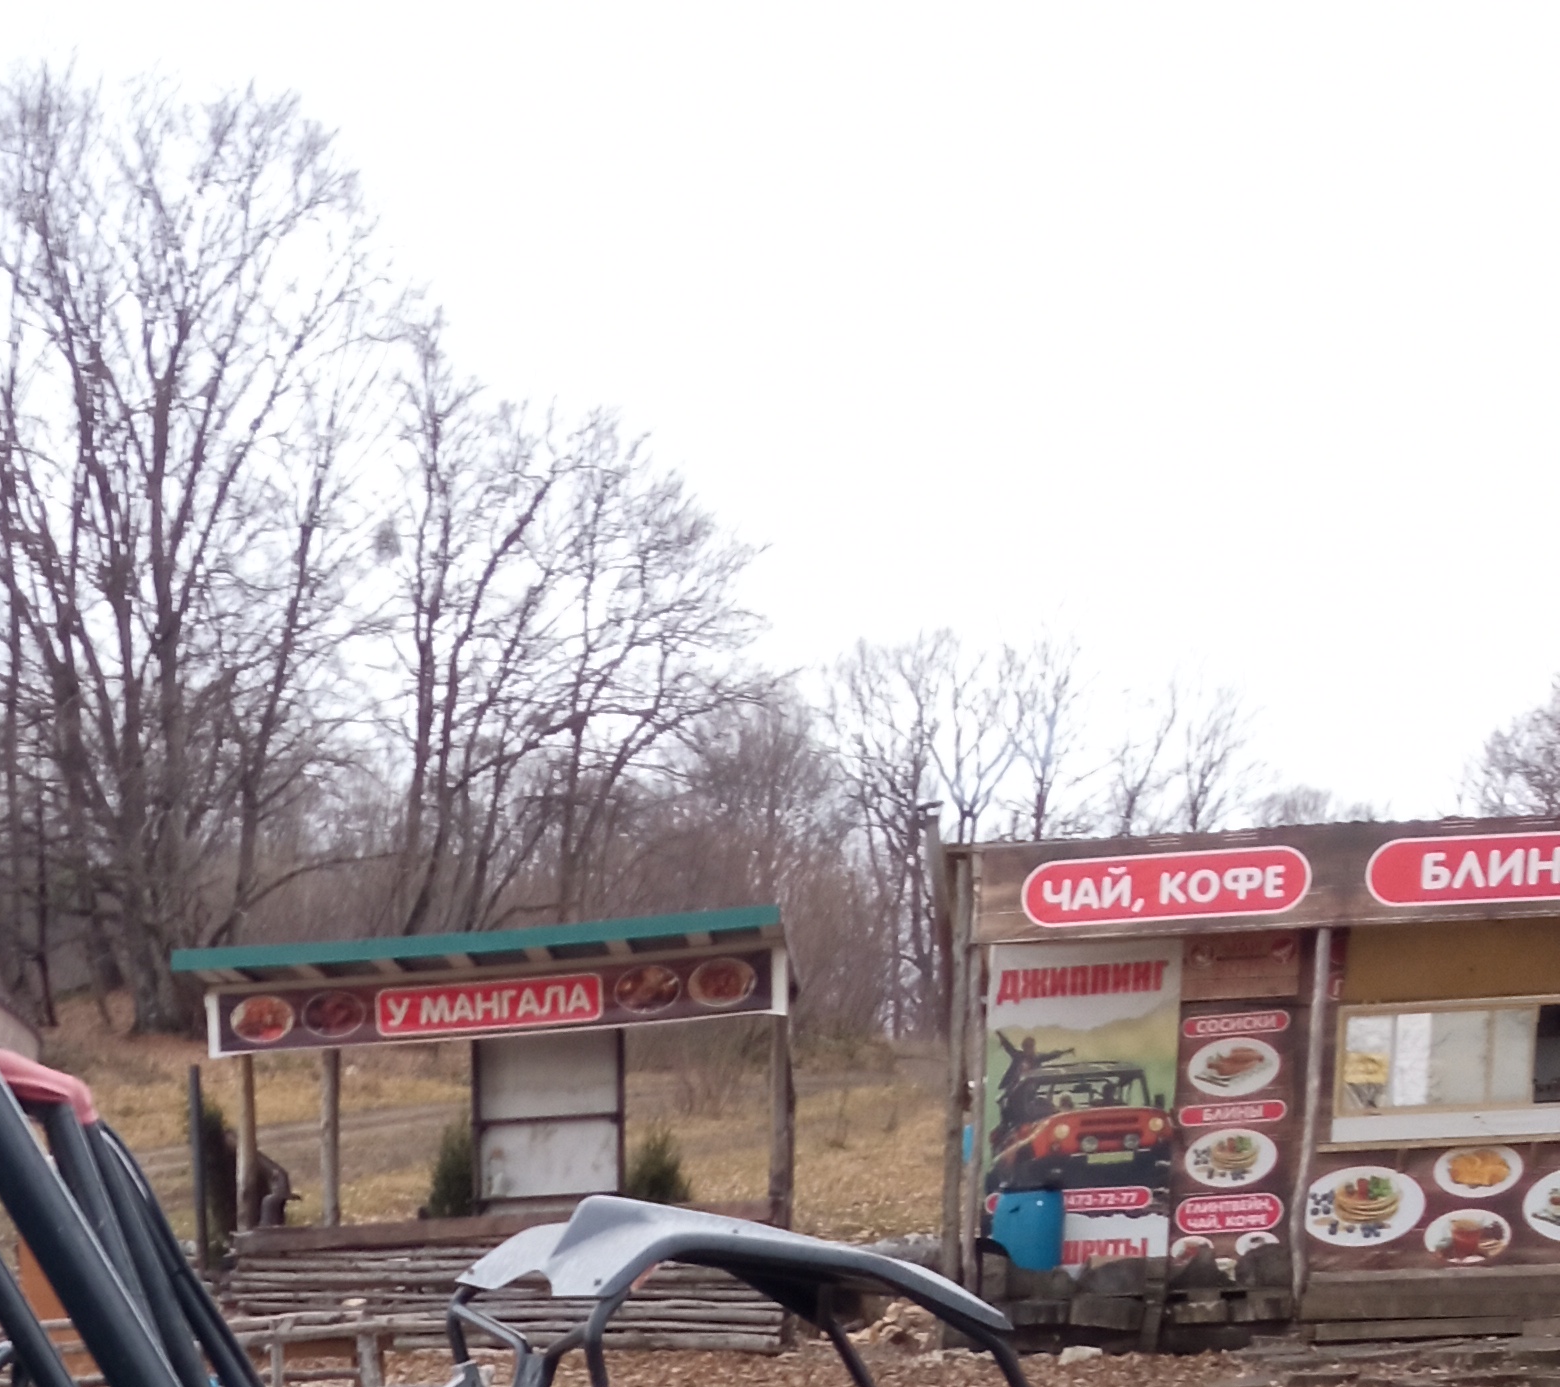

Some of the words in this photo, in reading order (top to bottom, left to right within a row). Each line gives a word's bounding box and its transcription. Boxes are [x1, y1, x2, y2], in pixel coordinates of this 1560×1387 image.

[1043, 866, 1145, 912] ЧАЙ,
[1158, 865, 1286, 905] КОФЕ
[1421, 846, 1560, 890] БЛИН
[386, 997, 410, 1027] У
[419, 983, 591, 1026] МАНГАЛА
[996, 960, 1169, 1006] ДЖИППИНГ
[1195, 1014, 1277, 1034] СОСИСКИ
[1202, 1104, 1265, 1121] БЛИНЫ
